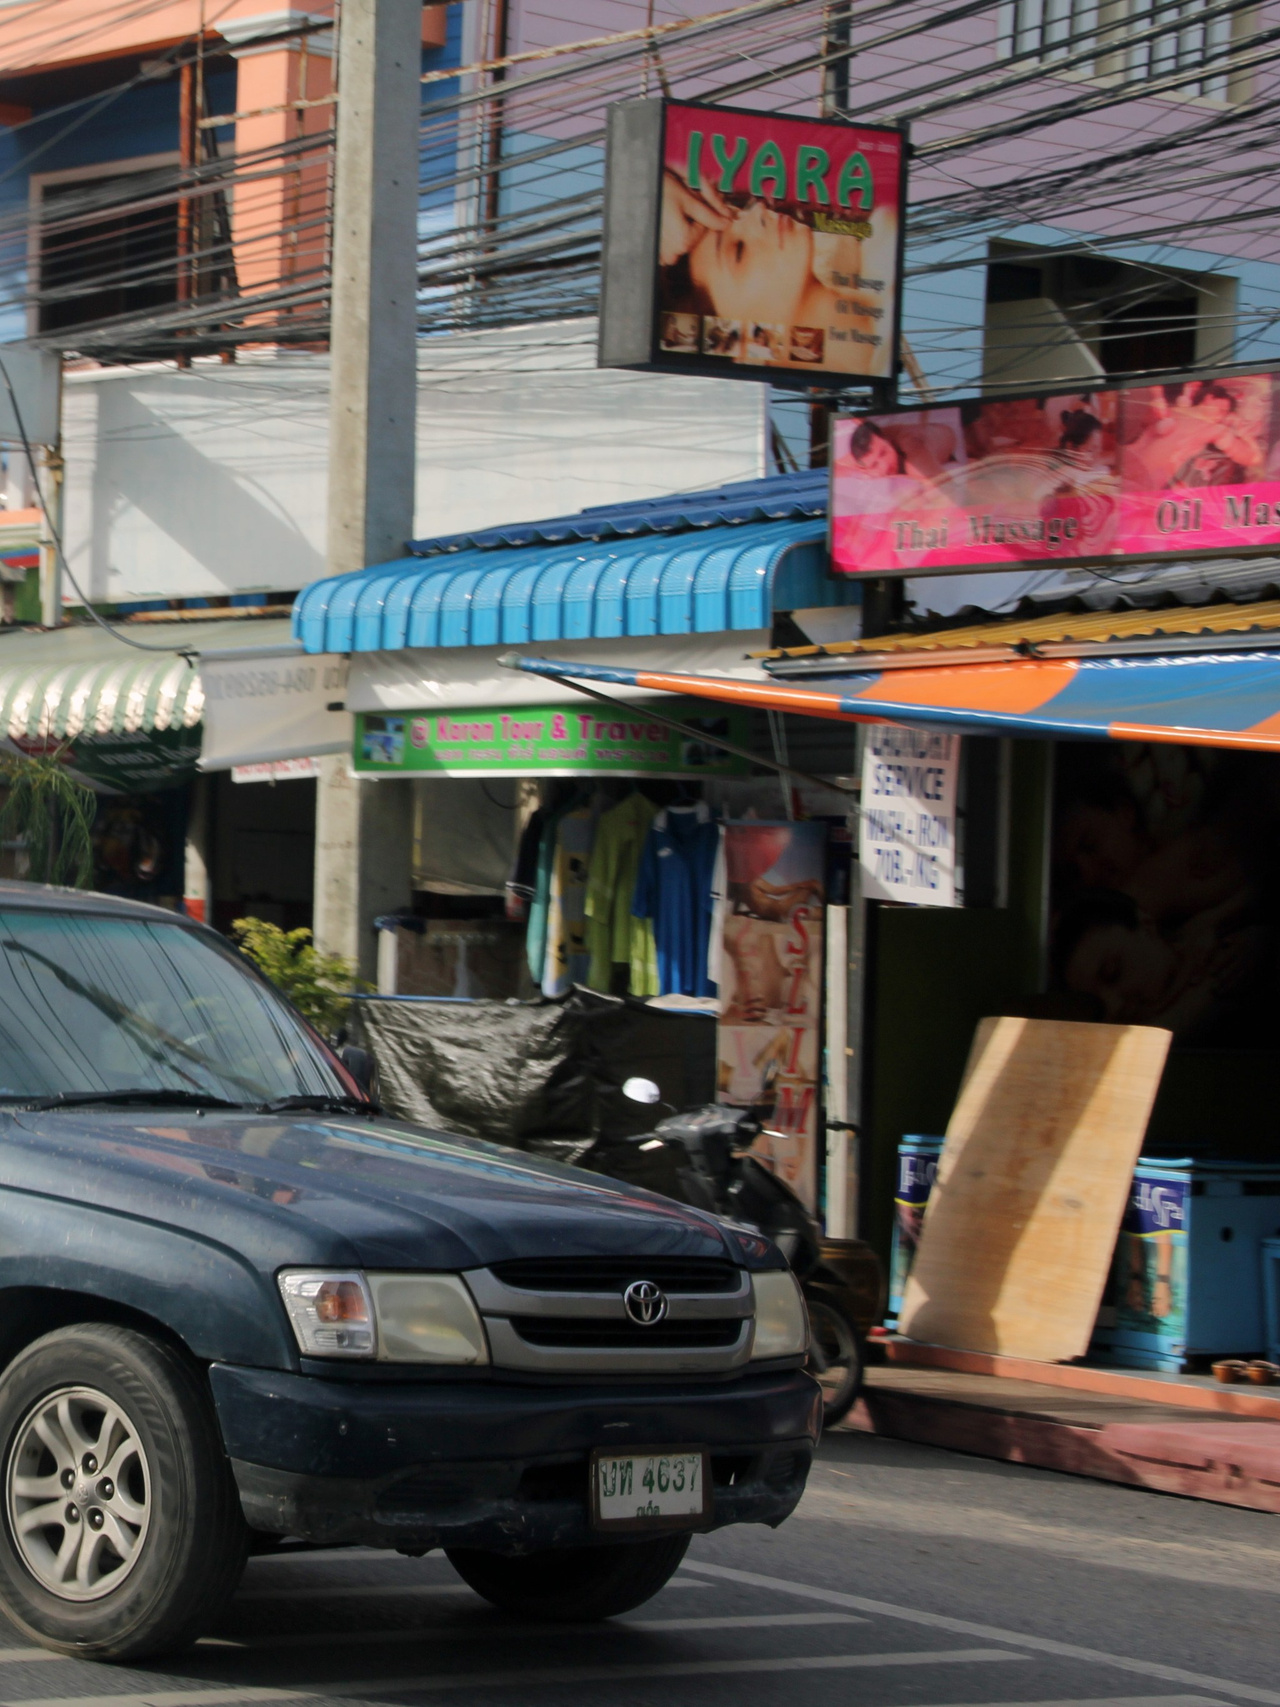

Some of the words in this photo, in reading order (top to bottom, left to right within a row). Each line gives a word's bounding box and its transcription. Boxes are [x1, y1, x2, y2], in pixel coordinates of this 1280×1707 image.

[687, 131, 874, 211] IYARA
[892, 517, 949, 550] Thai
[965, 515, 1079, 551] Massage
[1156, 498, 1203, 533] Oil
[436, 716, 494, 742] Karon
[499, 714, 544, 741] Tour
[550, 712, 569, 741] &
[577, 713, 670, 743] Travel
[873, 764, 945, 800] SERVICE
[641, 1455, 701, 1494] 4637
